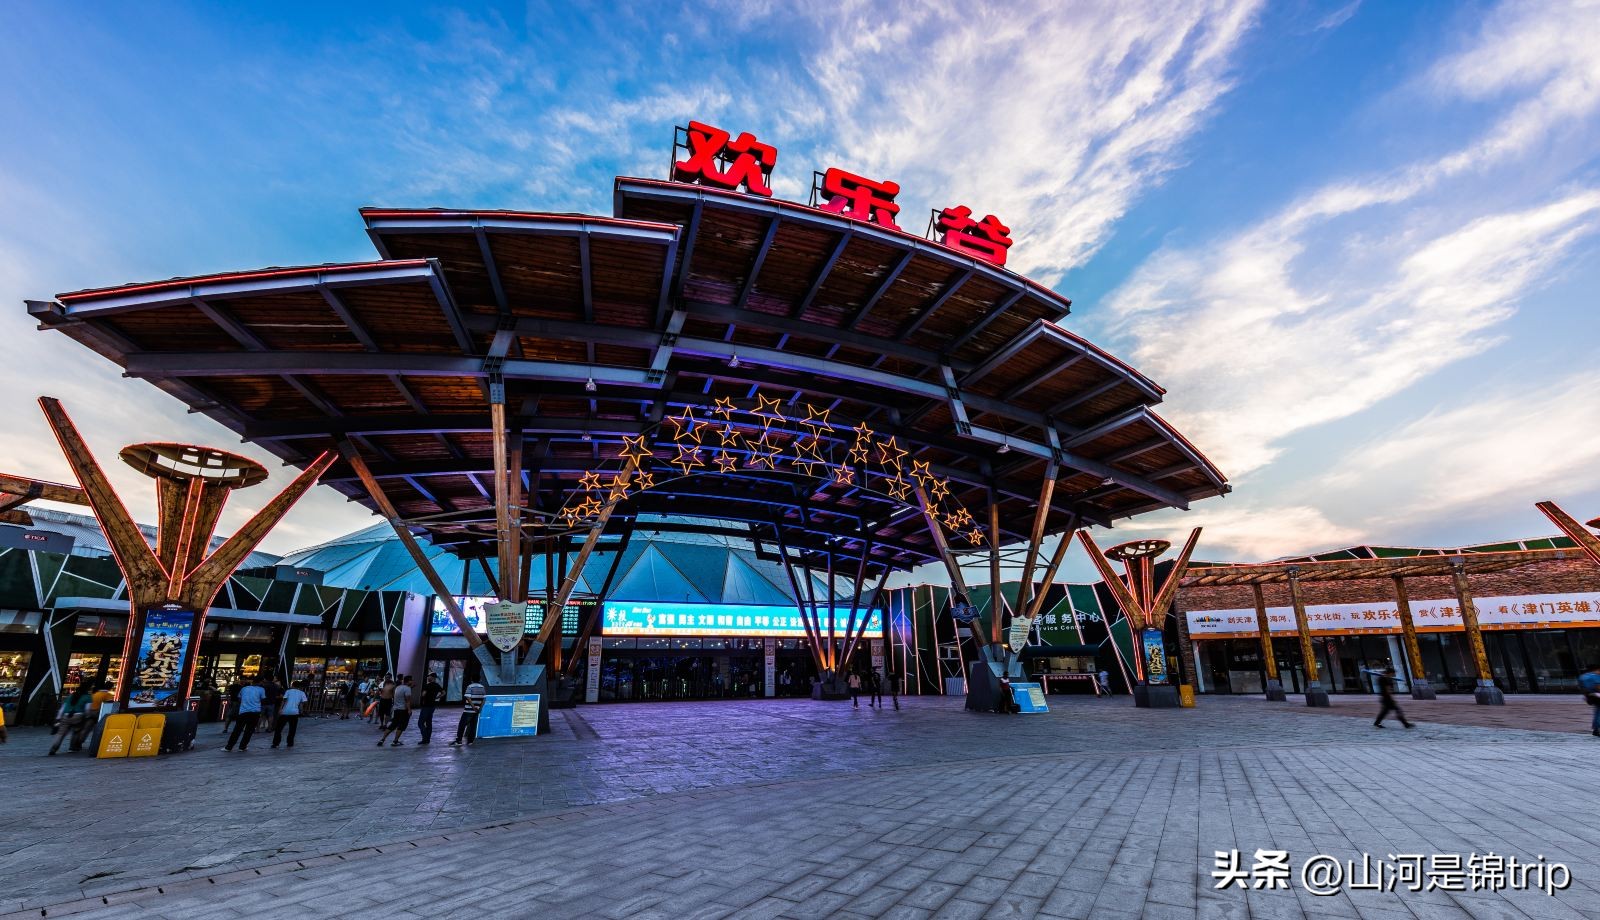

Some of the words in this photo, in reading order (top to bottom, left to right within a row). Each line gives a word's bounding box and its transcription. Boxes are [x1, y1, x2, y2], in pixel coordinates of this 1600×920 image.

[673, 120, 1013, 267] 欢乐谷
[1032, 612, 1099, 625] 客服务中心
